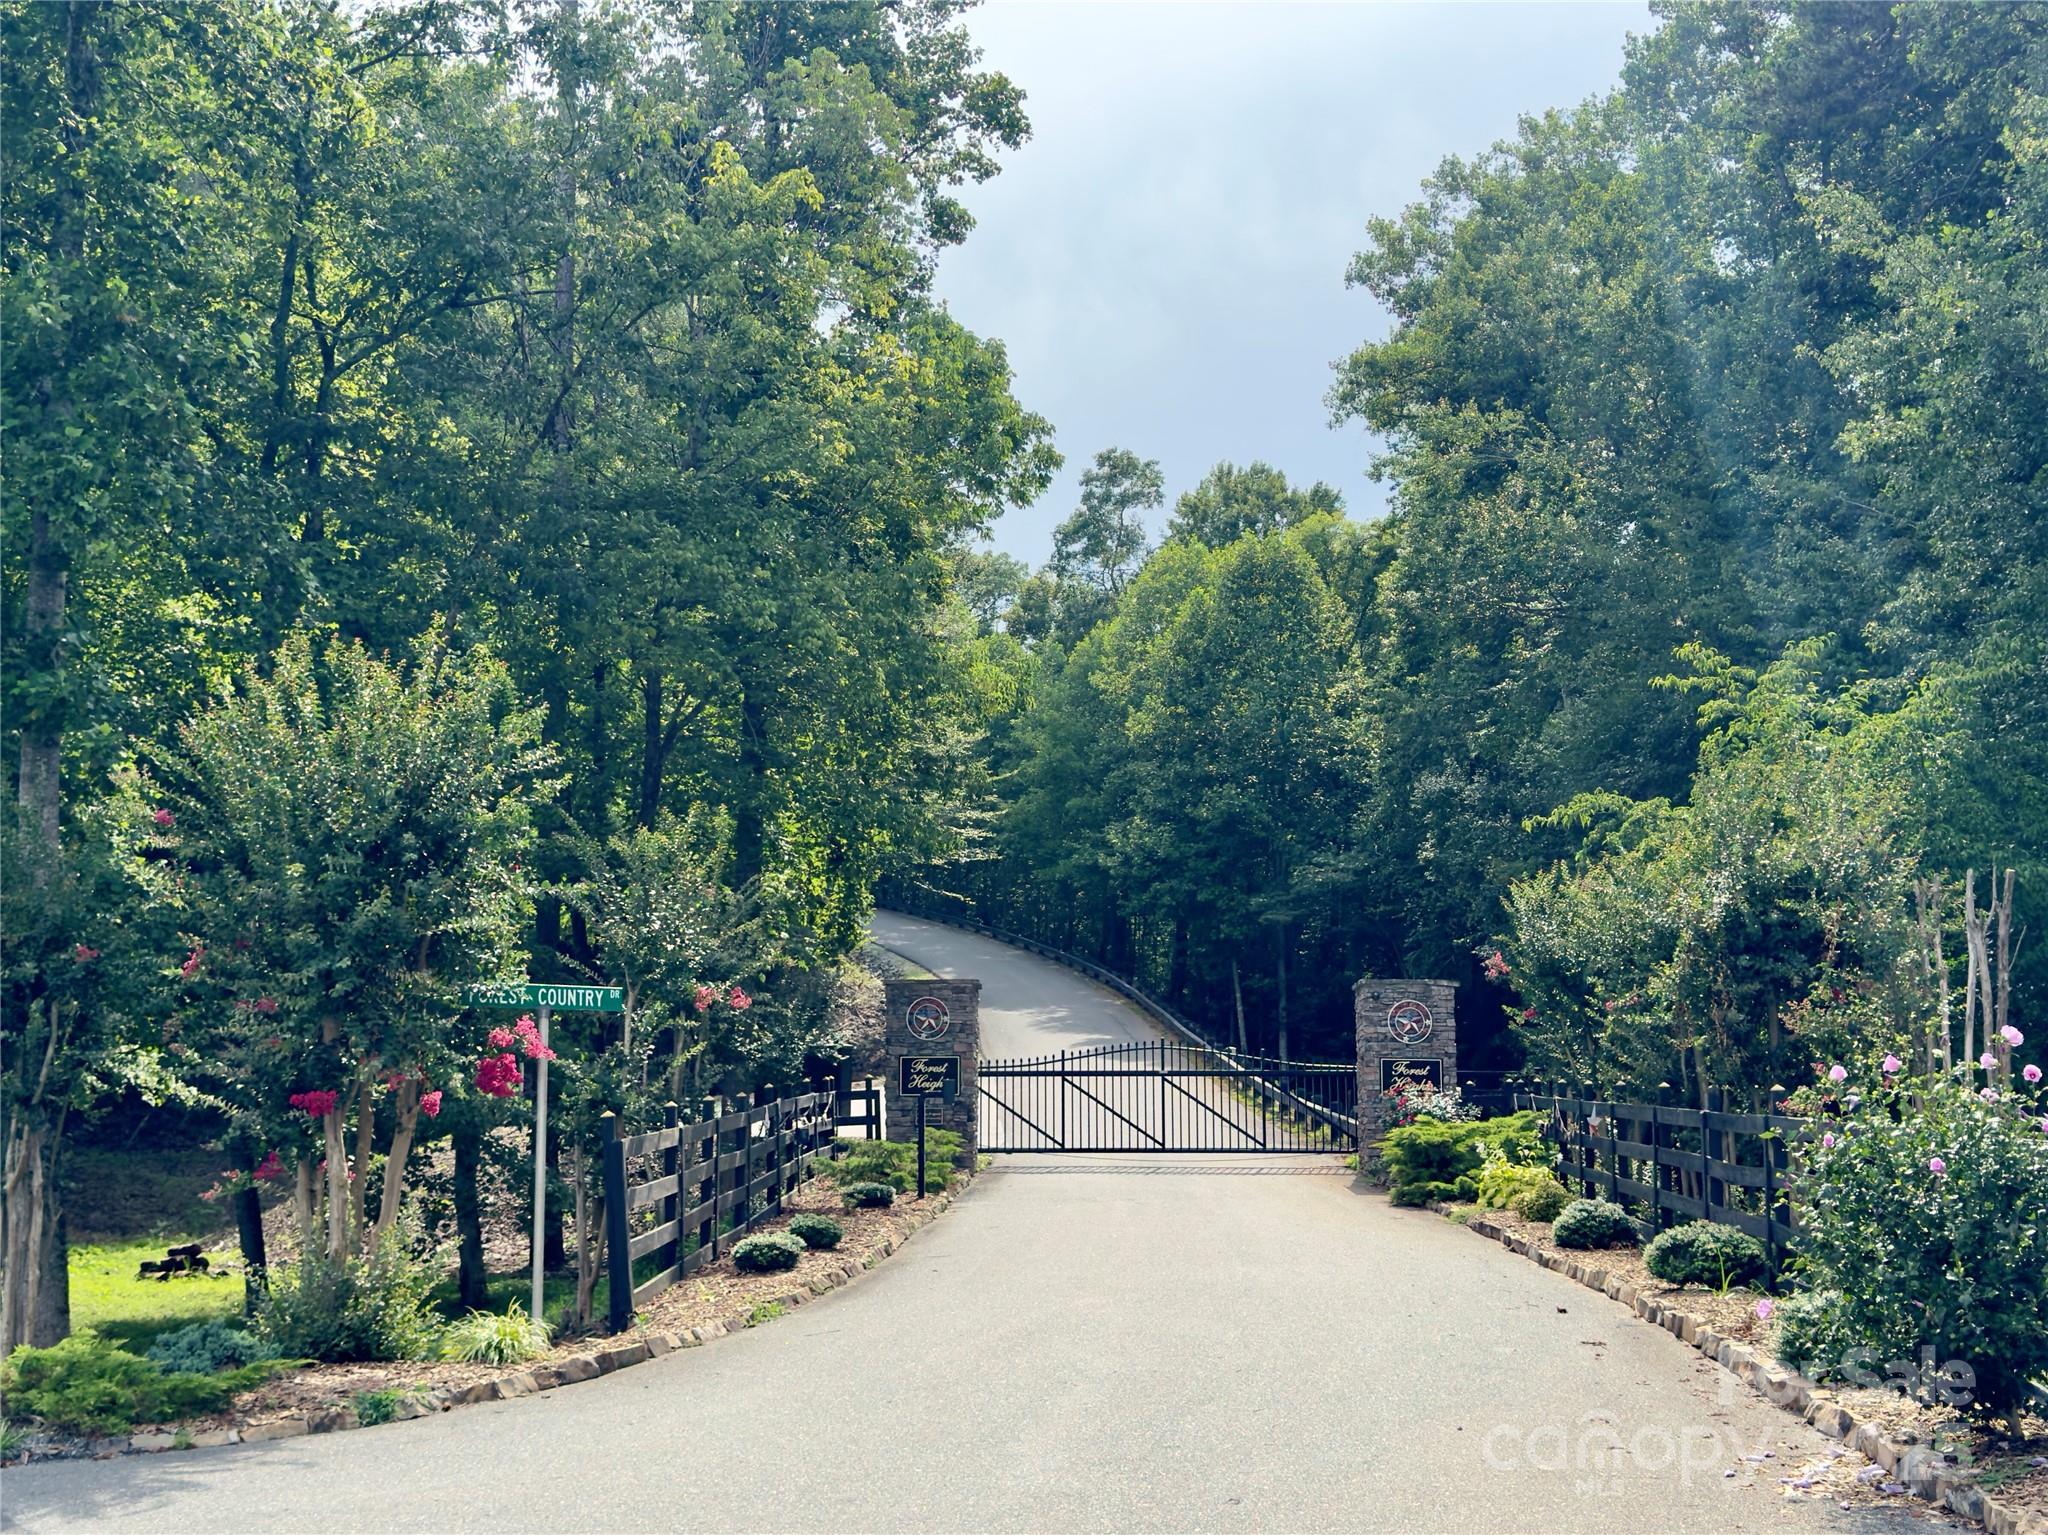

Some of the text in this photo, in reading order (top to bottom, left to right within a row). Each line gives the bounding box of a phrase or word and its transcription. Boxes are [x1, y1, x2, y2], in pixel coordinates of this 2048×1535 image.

[538, 988, 604, 1006] COUNTRY
[610, 990, 620, 999] DR
[911, 1059, 948, 1073] Forest
[1392, 1061, 1431, 1075] Forest
[908, 1074, 944, 1091] Heigh
